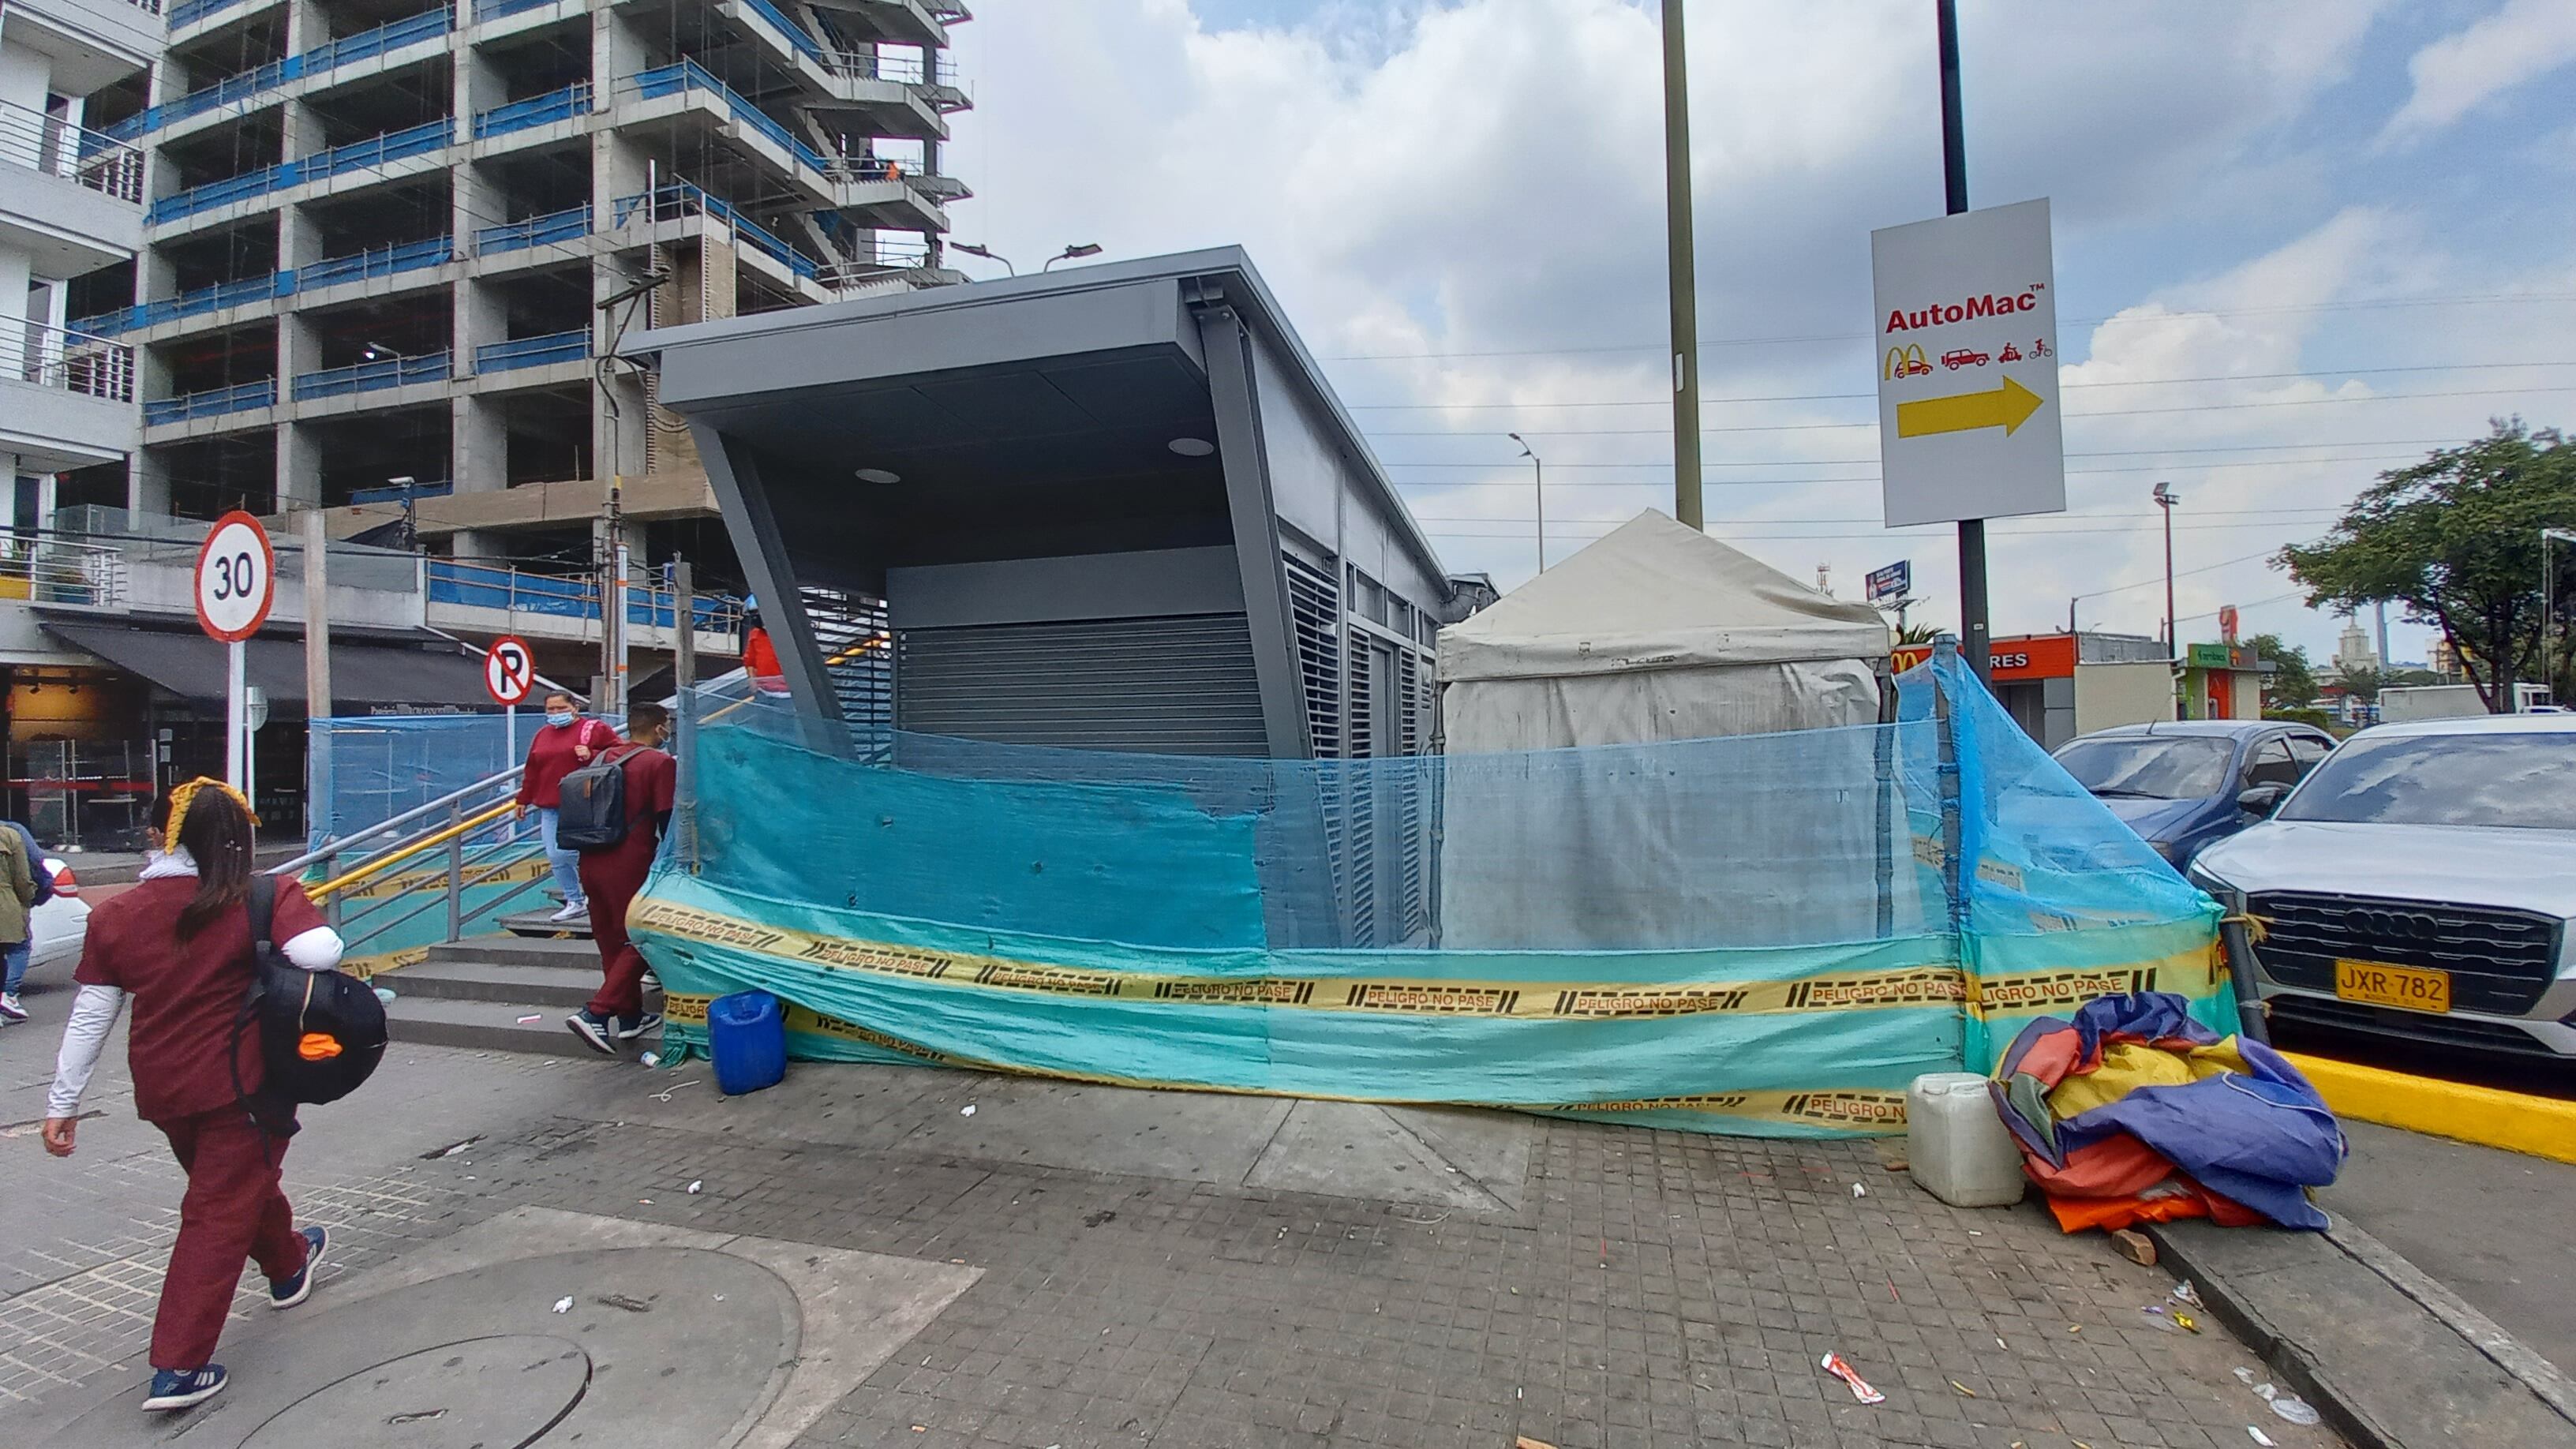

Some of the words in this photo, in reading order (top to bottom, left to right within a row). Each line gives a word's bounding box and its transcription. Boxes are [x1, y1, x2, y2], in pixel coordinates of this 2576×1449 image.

[213, 552, 253, 601] 30
[1989, 653, 2027, 668] RES
[500, 650, 523, 694] P
[650, 912, 704, 930] PELIGRO
[704, 924, 725, 936] NO
[724, 929, 758, 941] PASE
[822, 949, 874, 964] PELIGRO
[876, 956, 896, 968] NO
[897, 960, 929, 972] PASE
[993, 972, 1044, 986] PELIGRO
[1174, 983, 1231, 995] PELIGRO
[1234, 984, 1253, 997] NO
[1256, 985, 1291, 998] PASE
[1367, 990, 1428, 1005] PELIGRO
[1432, 993, 1454, 1005] NO
[1458, 994, 1494, 1007] PASE
[1812, 986, 1888, 1001] PELIGRO
[1893, 982, 1919, 996] NO
[1980, 987, 2036, 1003] LIGRO
[2042, 983, 2069, 997] NO
[2072, 978, 2125, 993] PASE
[1578, 998, 1644, 1009] PELIGRO
[1649, 997, 1672, 1009] NO
[1677, 998, 1719, 1009] PASE
[1810, 1098, 1886, 1118] PELIGRO
[1893, 1106, 1904, 1118] N
